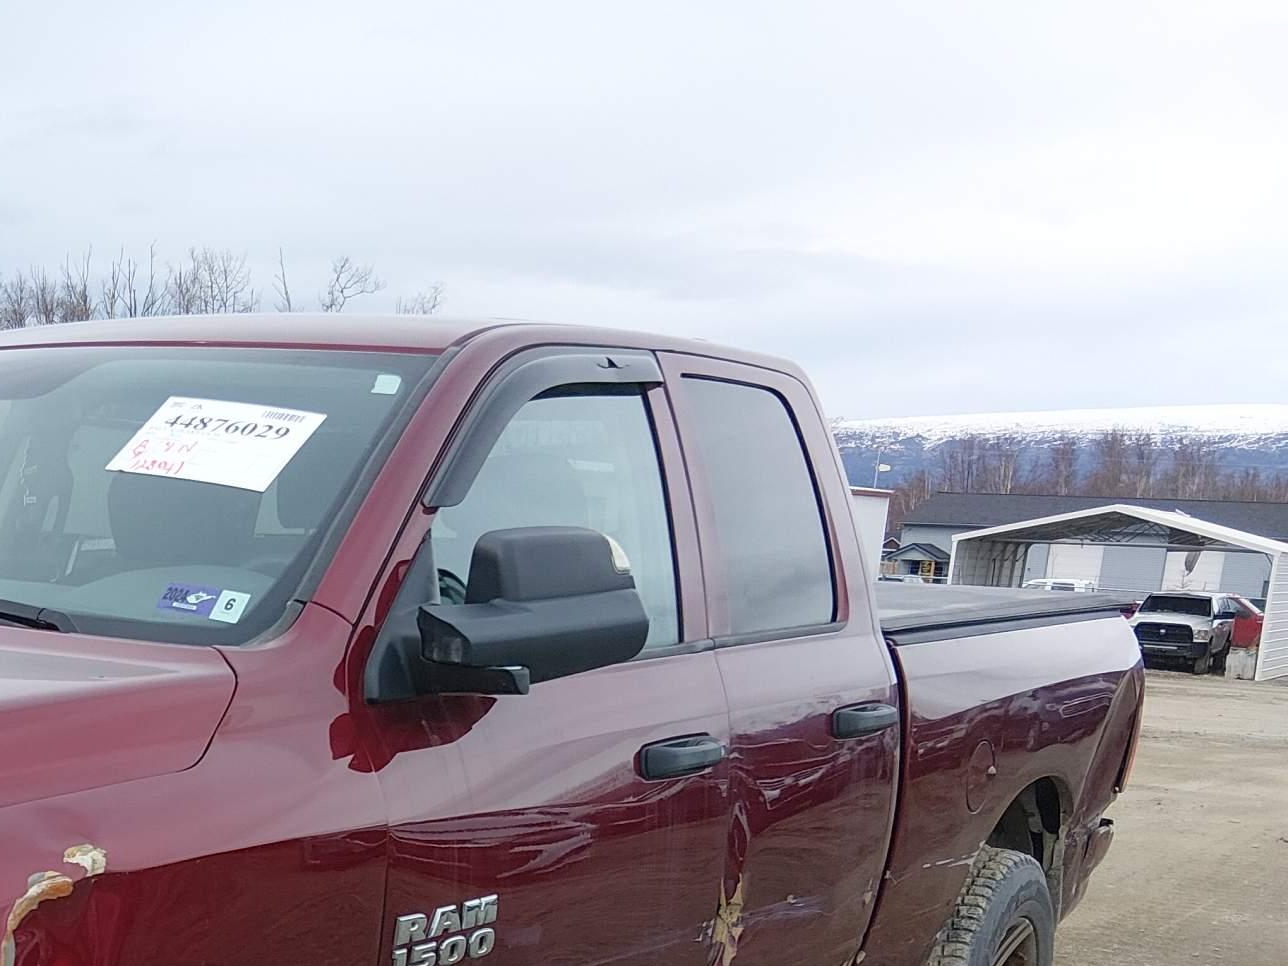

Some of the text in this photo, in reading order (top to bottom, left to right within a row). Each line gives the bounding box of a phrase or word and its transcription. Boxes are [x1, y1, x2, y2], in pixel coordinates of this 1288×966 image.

[164, 413, 290, 441] 44876029
[223, 598, 237, 611] 6
[394, 894, 499, 945] RAM
